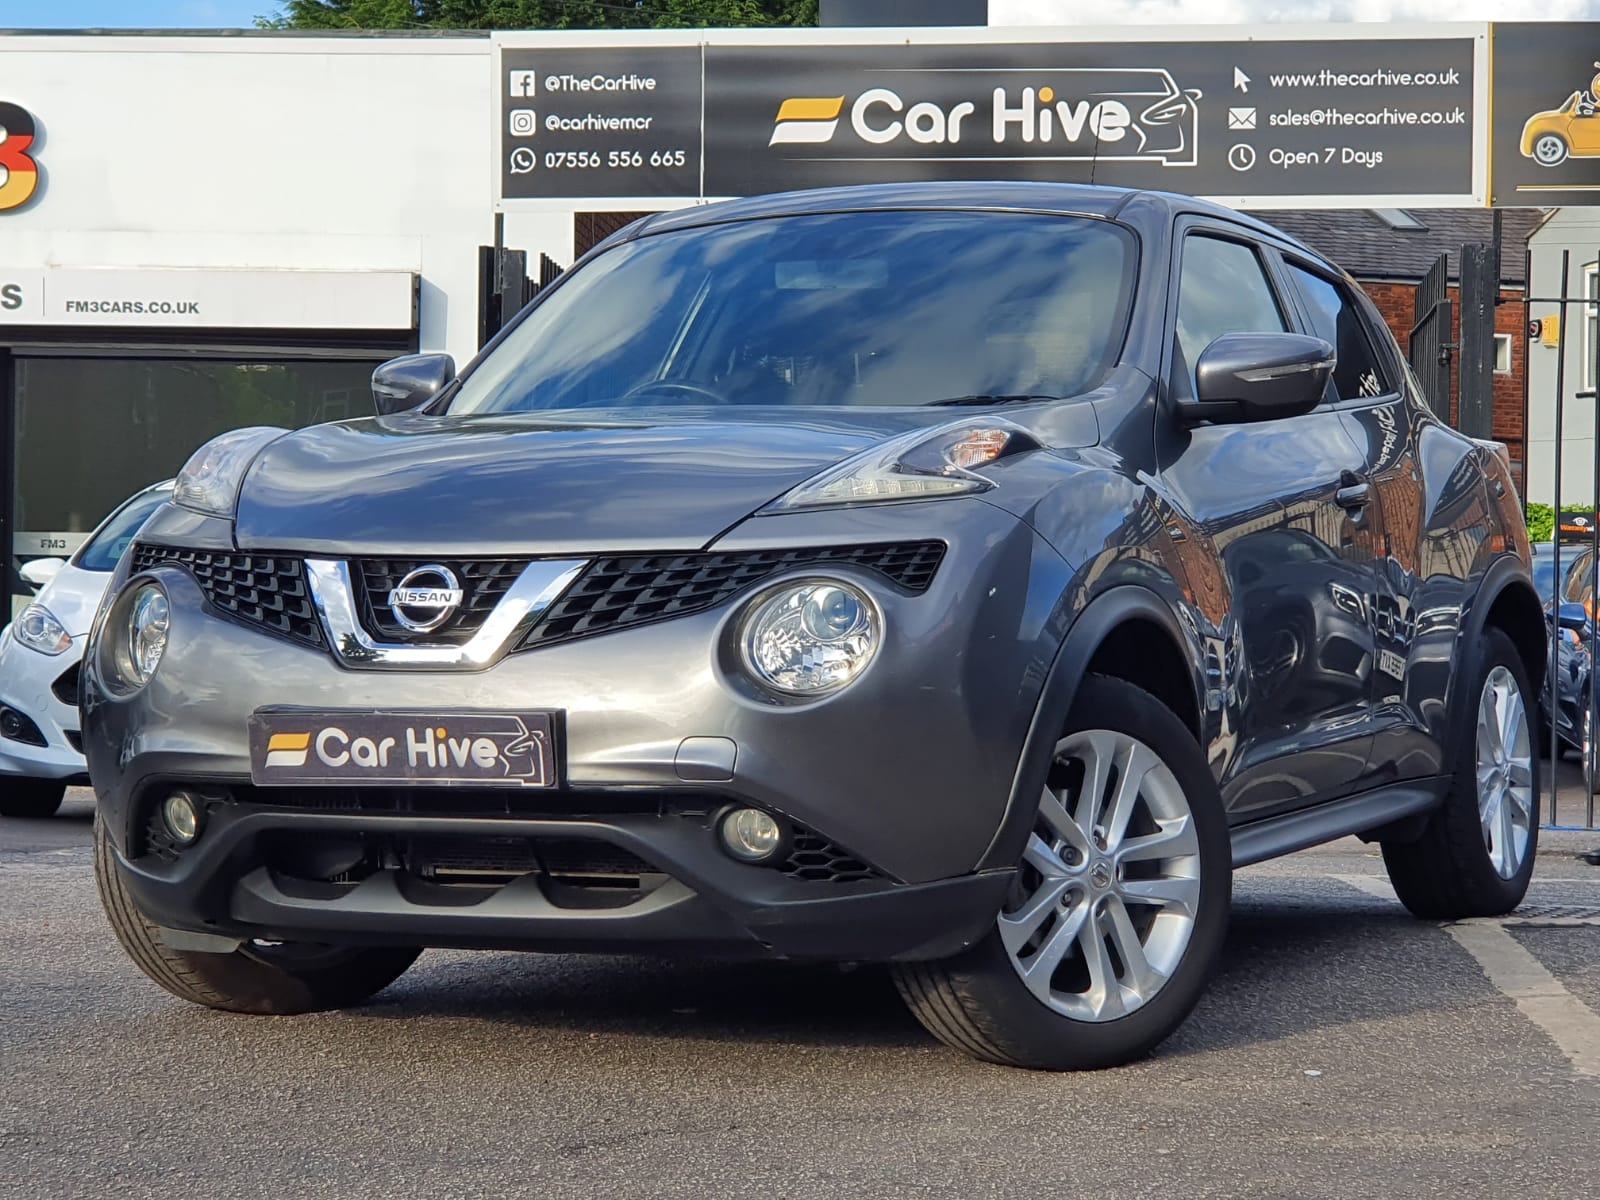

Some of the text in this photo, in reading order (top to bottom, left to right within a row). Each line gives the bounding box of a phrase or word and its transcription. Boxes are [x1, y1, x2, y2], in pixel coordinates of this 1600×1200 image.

[544, 74, 657, 92] @TheCarHive
[1269, 68, 1460, 88] www.thecarhive.co.uk
[544, 113, 653, 131] @carhivemcr
[850, 86, 1132, 144] Car Hive
[1268, 107, 1466, 127] sales@thecarhive.co.uk
[544, 150, 686, 169] 07556 556 665
[1268, 147, 1384, 168] Open 7 Days
[65, 301, 200, 315] FM3CARS.CO.UK
[40, 539, 66, 549] FM3
[393, 591, 452, 602] NISSAN
[316, 727, 499, 768] Car Hive
